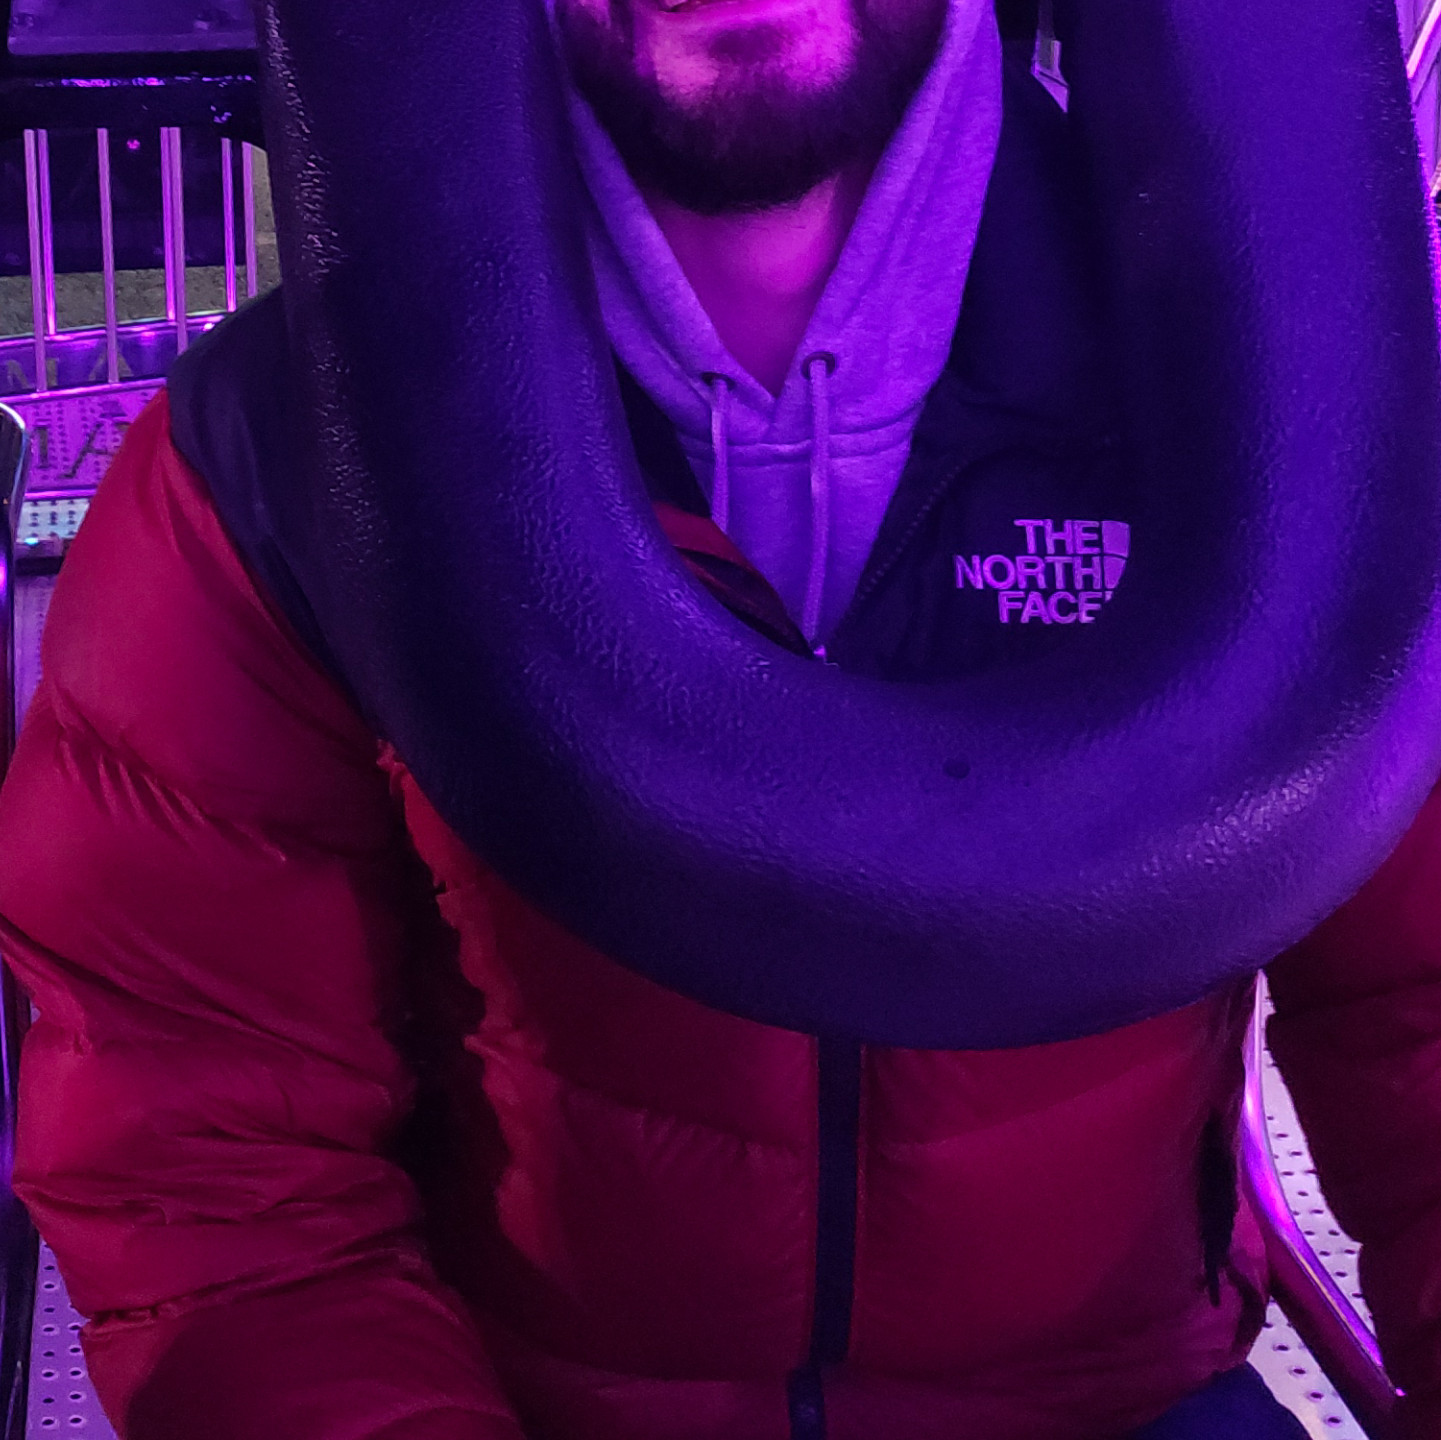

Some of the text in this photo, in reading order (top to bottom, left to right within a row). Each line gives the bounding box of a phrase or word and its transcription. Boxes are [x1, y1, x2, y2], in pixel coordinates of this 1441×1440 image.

[1013, 518, 1102, 555] THE
[954, 553, 1102, 590] NORTH
[997, 590, 1103, 625] FACE
